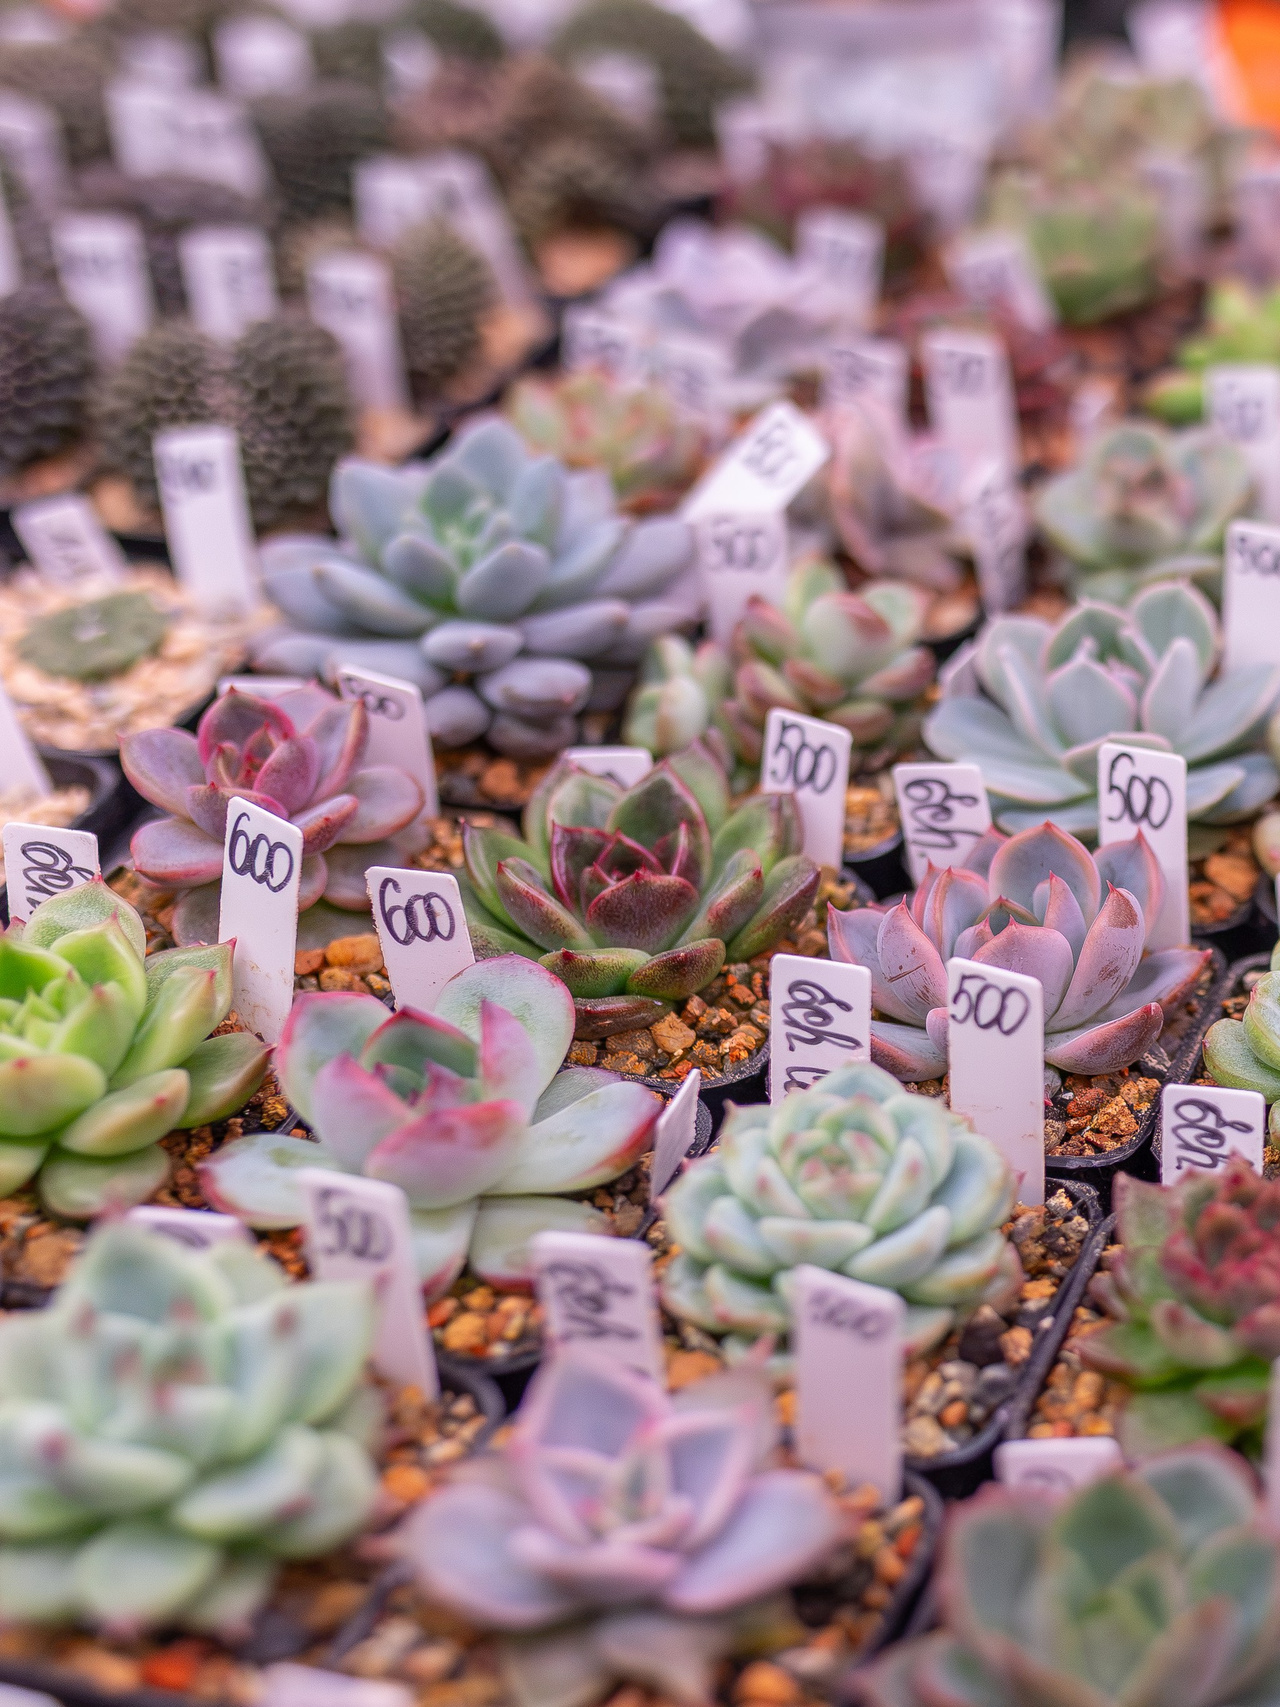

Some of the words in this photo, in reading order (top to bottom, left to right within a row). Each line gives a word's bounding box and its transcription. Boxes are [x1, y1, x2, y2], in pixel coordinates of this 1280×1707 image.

[770, 721, 838, 795] 500
[229, 812, 294, 893] 600
[379, 877, 466, 946] 600
[950, 974, 1030, 1036] 500
[316, 1186, 396, 1263] 500
